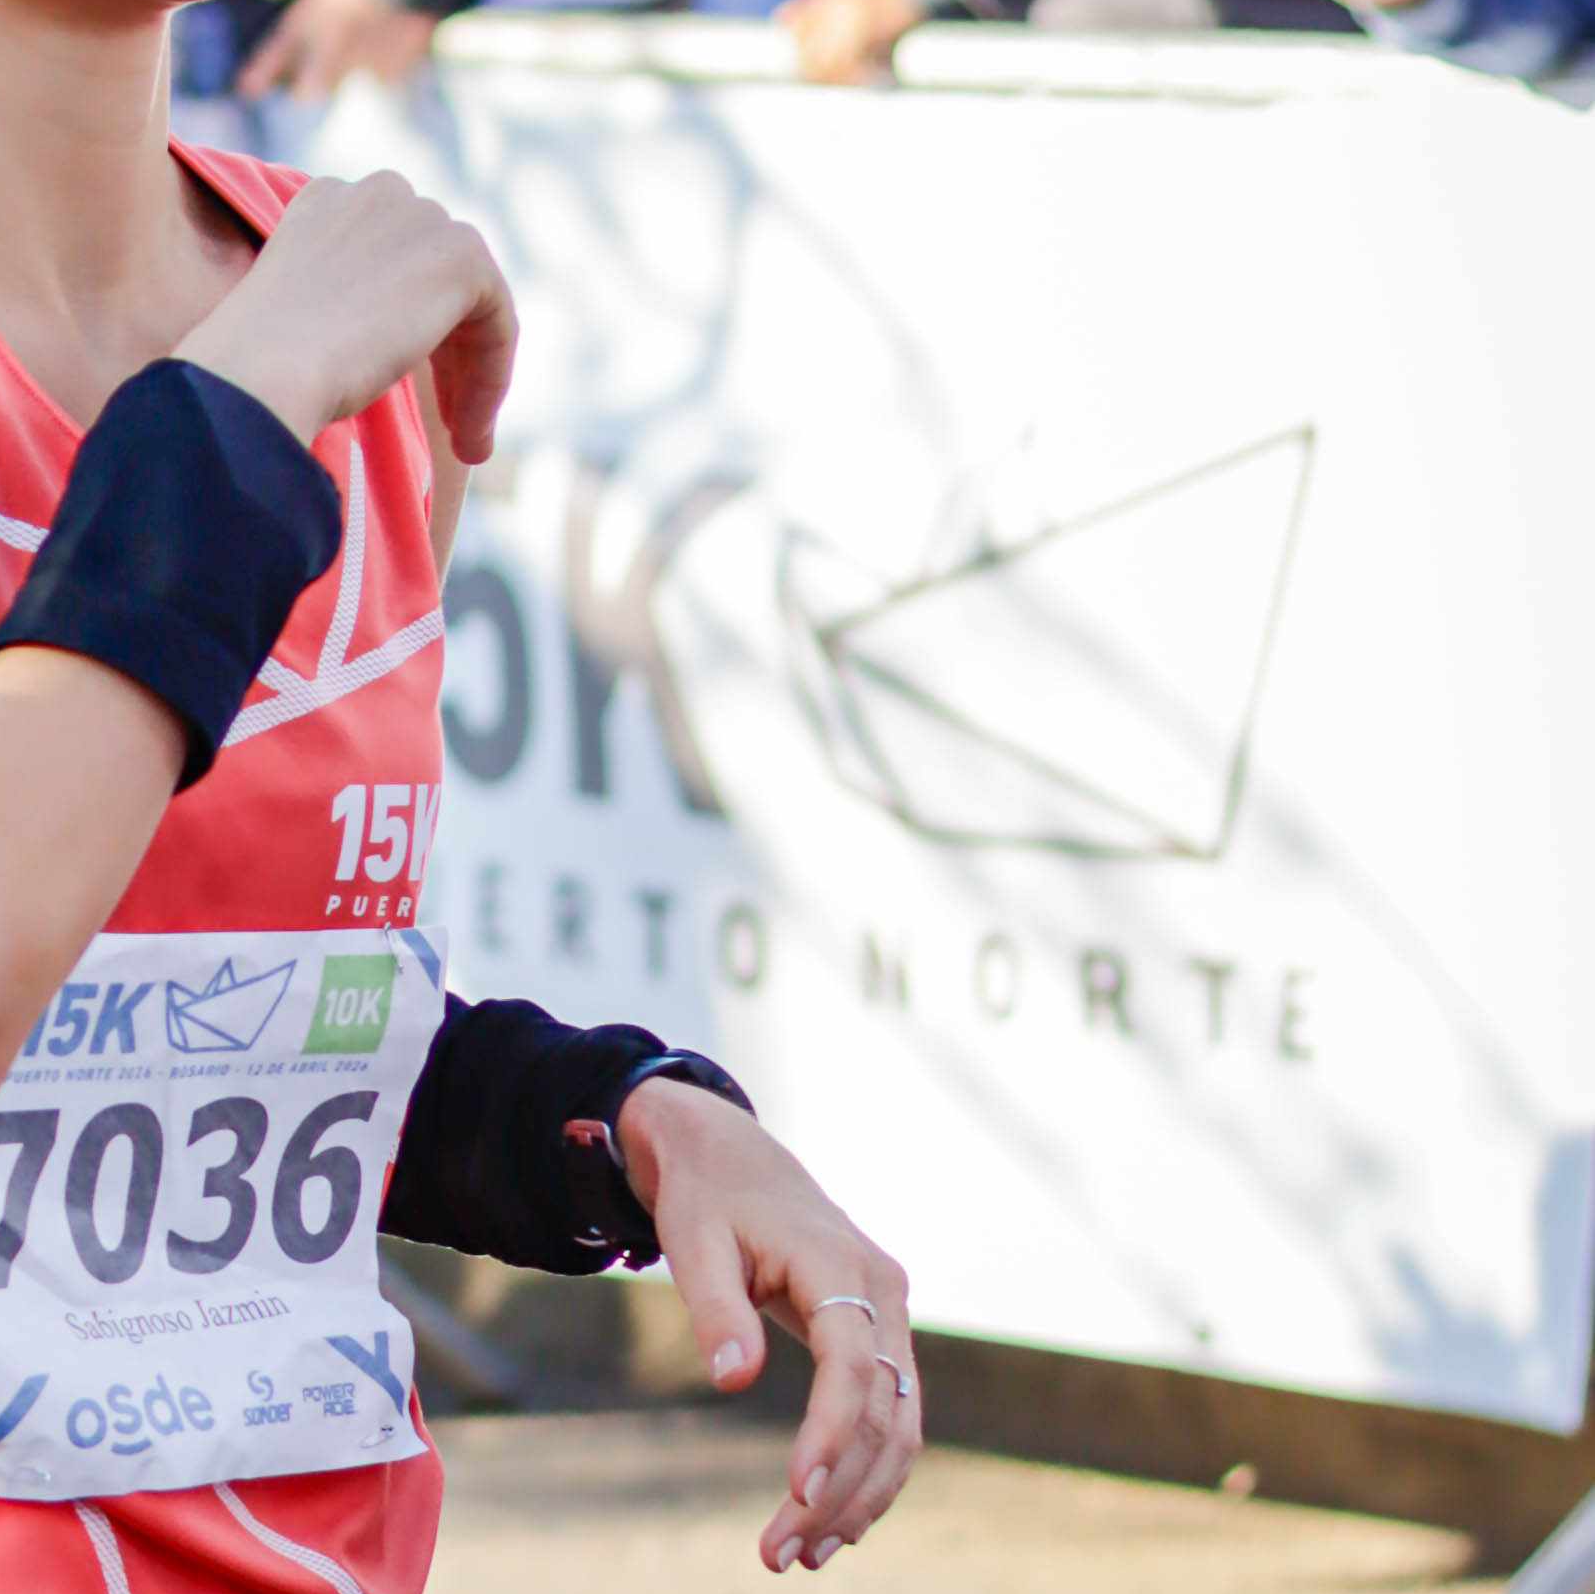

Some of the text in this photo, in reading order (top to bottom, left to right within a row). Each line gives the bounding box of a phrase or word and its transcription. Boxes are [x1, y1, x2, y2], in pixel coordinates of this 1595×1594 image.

[325, 895, 412, 917] PUER
[474, 859, 1317, 1061] ERTO NORTE
[323, 985, 383, 1027] 10K
[65, 1309, 194, 1345] Sabignoso
[65, 1372, 215, 1455] osde
